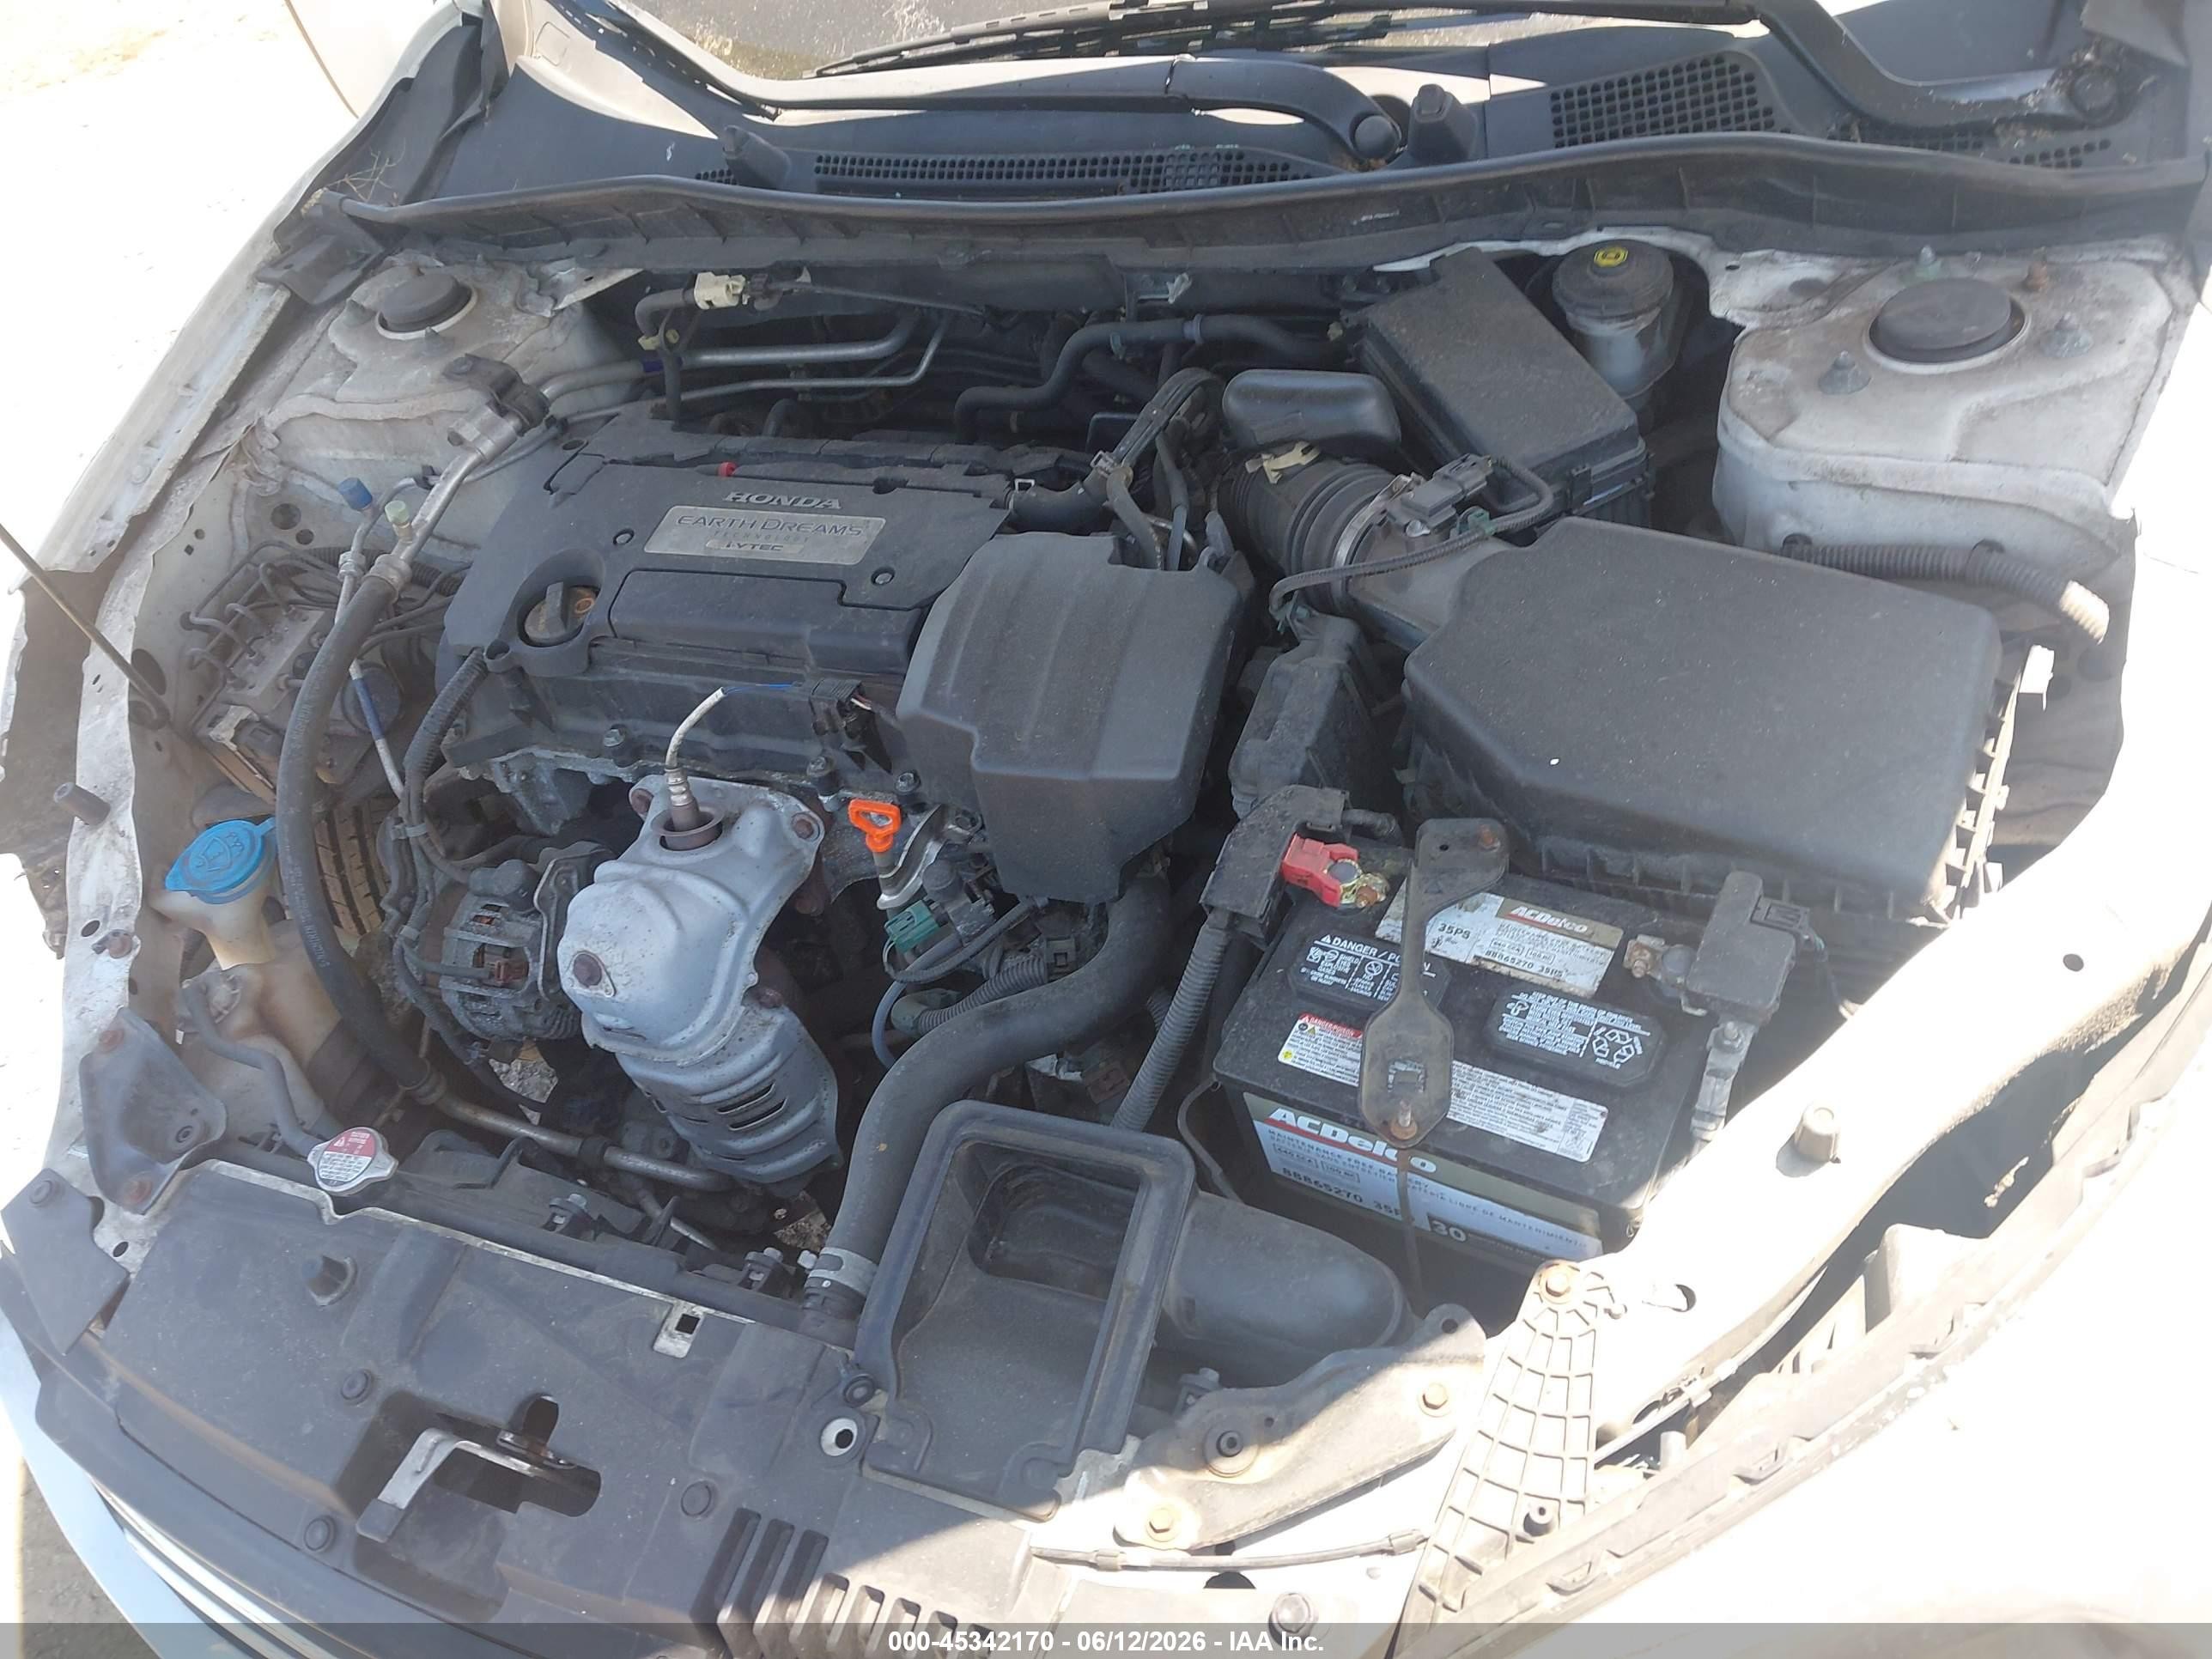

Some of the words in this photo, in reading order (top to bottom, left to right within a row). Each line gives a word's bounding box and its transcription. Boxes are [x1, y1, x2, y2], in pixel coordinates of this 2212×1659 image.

[724, 491, 842, 509] HONDA
[678, 515, 757, 530] EARTH
[761, 517, 863, 537] DREAMS
[1510, 905, 1588, 933] ACDelco
[1437, 922, 1472, 939] 35PS
[1331, 936, 1379, 957] DANGER
[1268, 1108, 1437, 1173] ACDelco
[1430, 1219, 1468, 1243] 30
